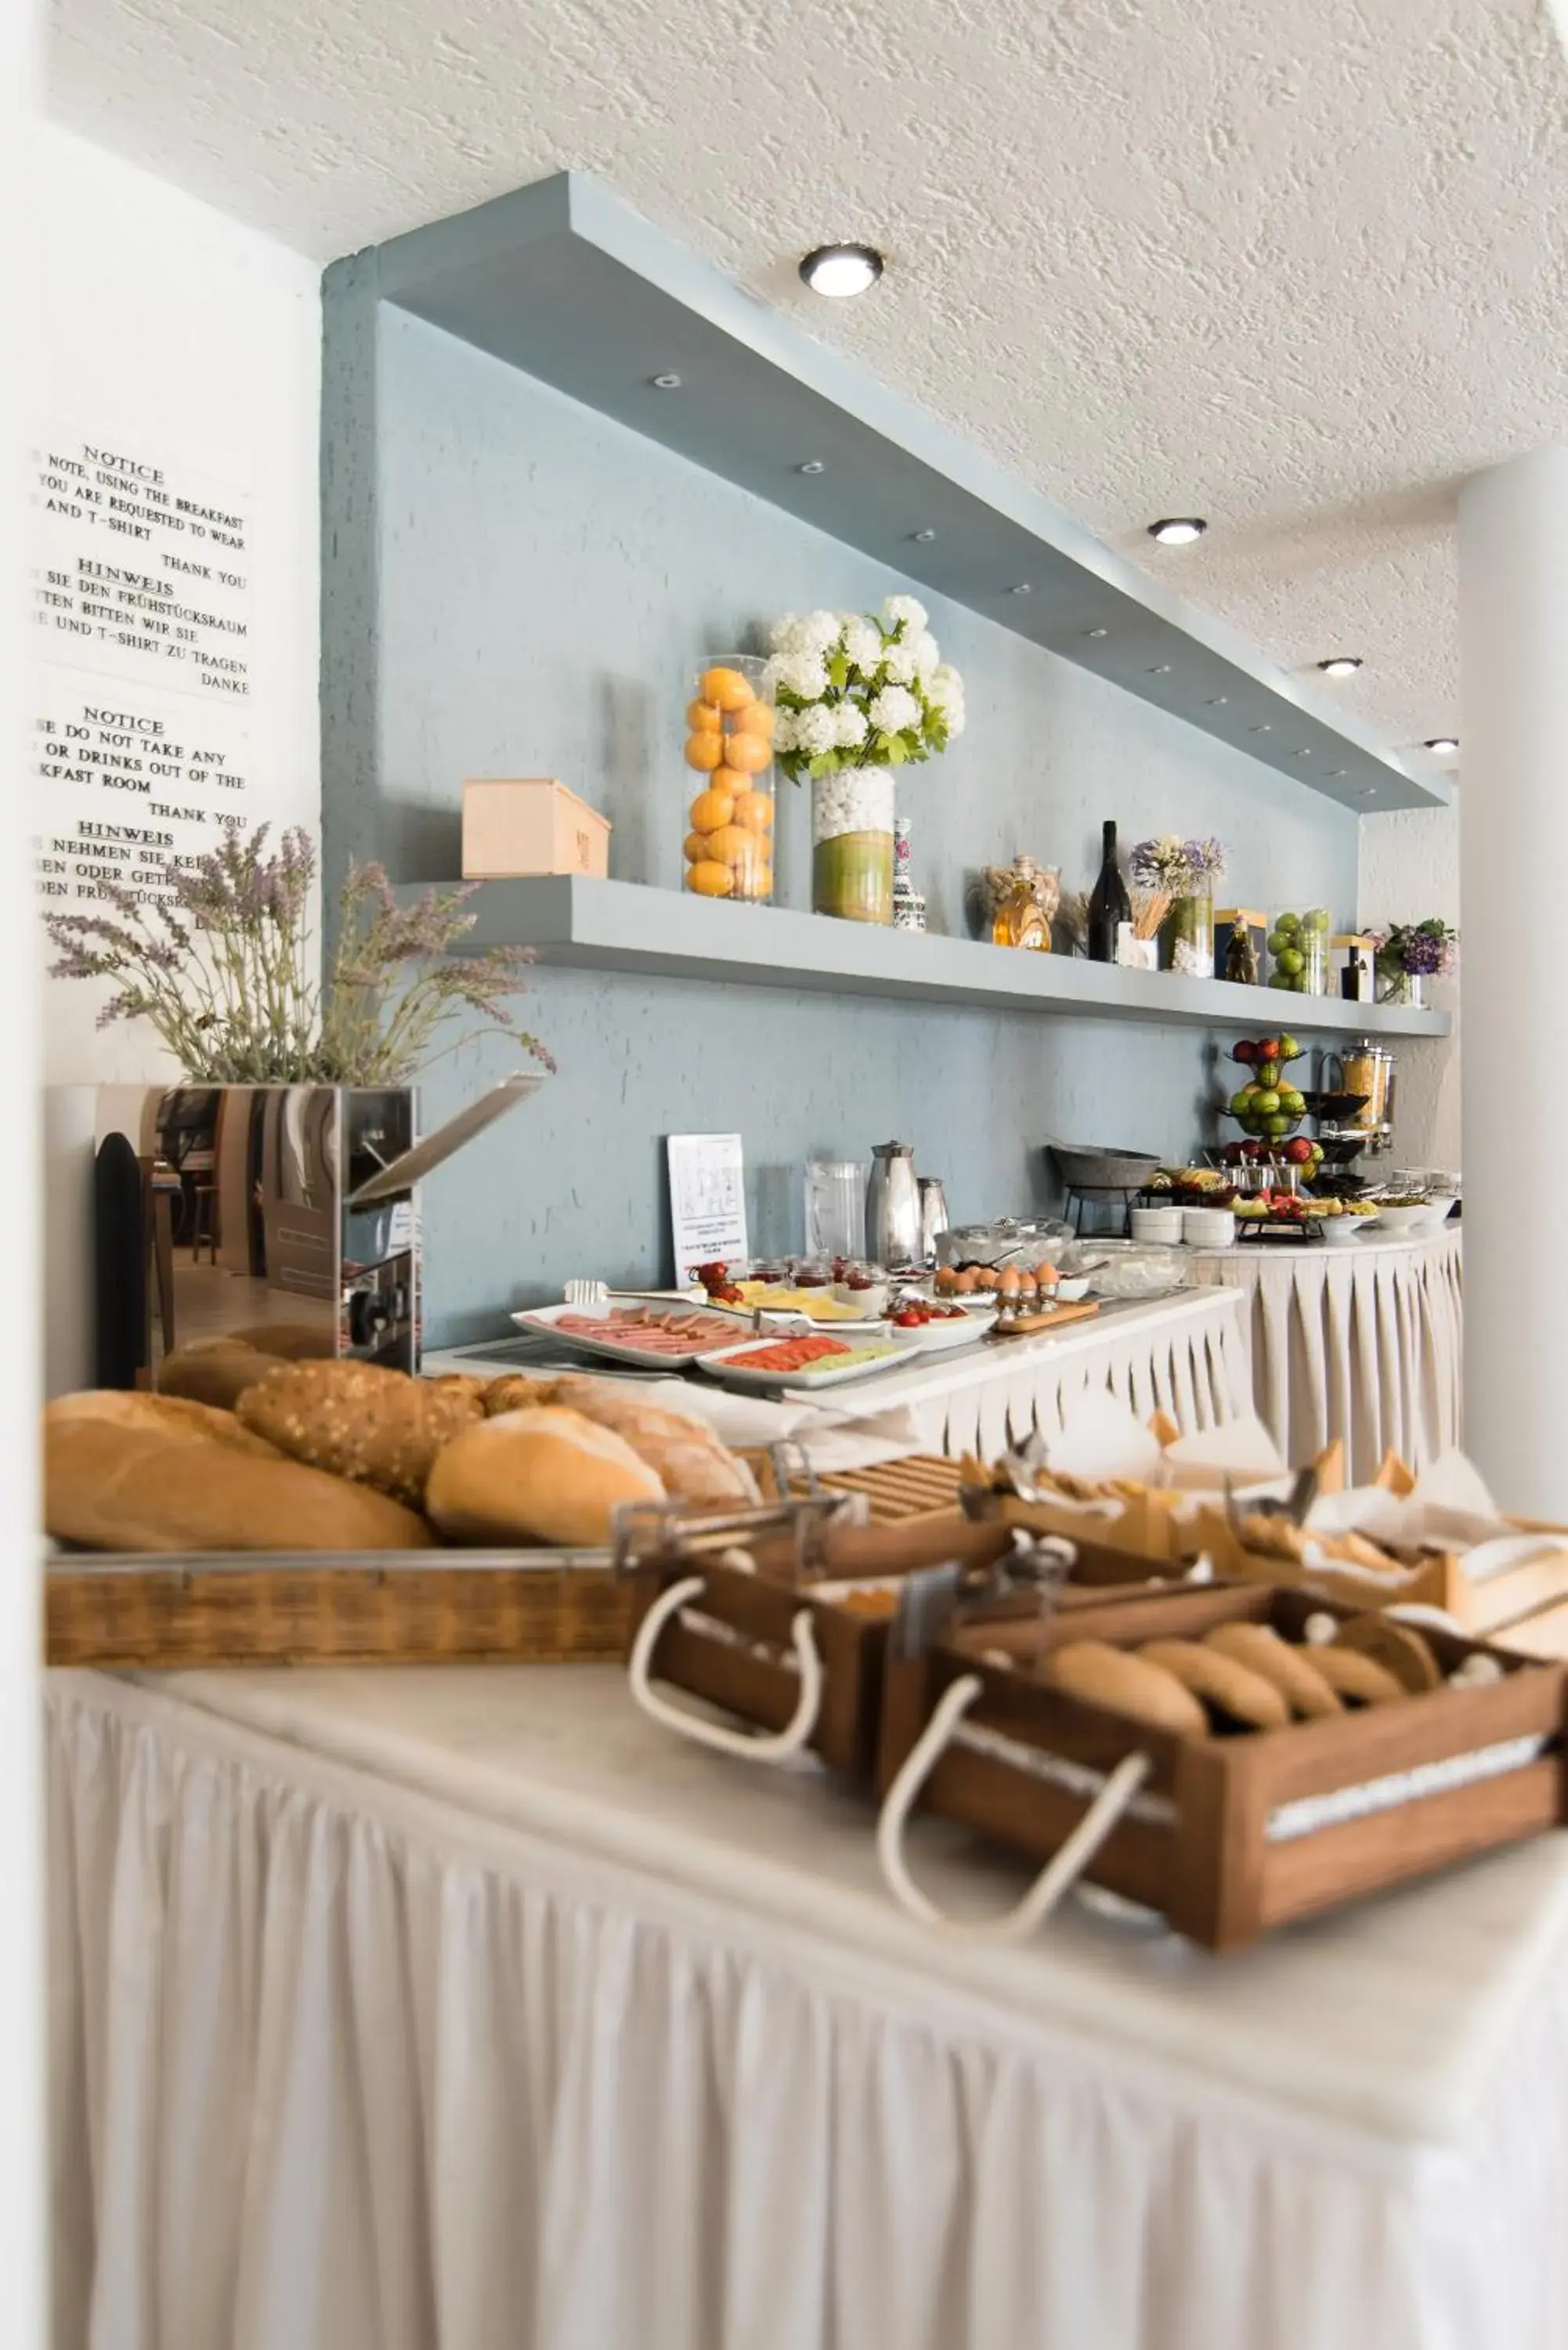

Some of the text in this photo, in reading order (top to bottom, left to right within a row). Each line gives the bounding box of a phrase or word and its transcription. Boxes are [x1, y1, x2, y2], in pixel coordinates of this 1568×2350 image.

[82, 444, 164, 485] NOTICE
[39, 472, 245, 550] YOU ARE REQUESTED TO WEAR
[46, 498, 81, 519] AND
[88, 510, 151, 540] T-SHIRT
[96, 470, 139, 496] USING
[144, 486, 170, 506] THE
[175, 498, 244, 531] BREAKFAST
[47, 570, 72, 588] SIE
[78, 579, 111, 598] DEN
[78, 557, 174, 597] HINWEIS
[161, 553, 247, 589] THANK YOU
[36, 590, 74, 609] TEN
[81, 601, 135, 625] BITTEN
[176, 626, 198, 644] SIE
[56, 615, 92, 635] UND
[167, 644, 187, 660] ZU
[191, 650, 247, 674] TRAGEN
[201, 672, 250, 695] DANKE
[83, 705, 164, 736] NOTICE
[65, 724, 91, 740] DO
[99, 731, 133, 749] NOT
[140, 739, 185, 759] TAKE
[191, 750, 226, 766] ANY
[45, 742, 70, 759] OR
[78, 748, 143, 772] DRINKS
[150, 762, 182, 778] OUT
[188, 768, 209, 783] OF
[215, 773, 246, 790] THE
[102, 772, 151, 794] ROOM
[148, 802, 247, 828] THANK YOU
[78, 821, 174, 848] HINWEIS
[37, 859, 67, 874] EN
[76, 864, 123, 881] ODER
[52, 838, 132, 860] NEHMEN
[139, 850, 166, 866] SIE
[174, 855, 201, 870] KEI
